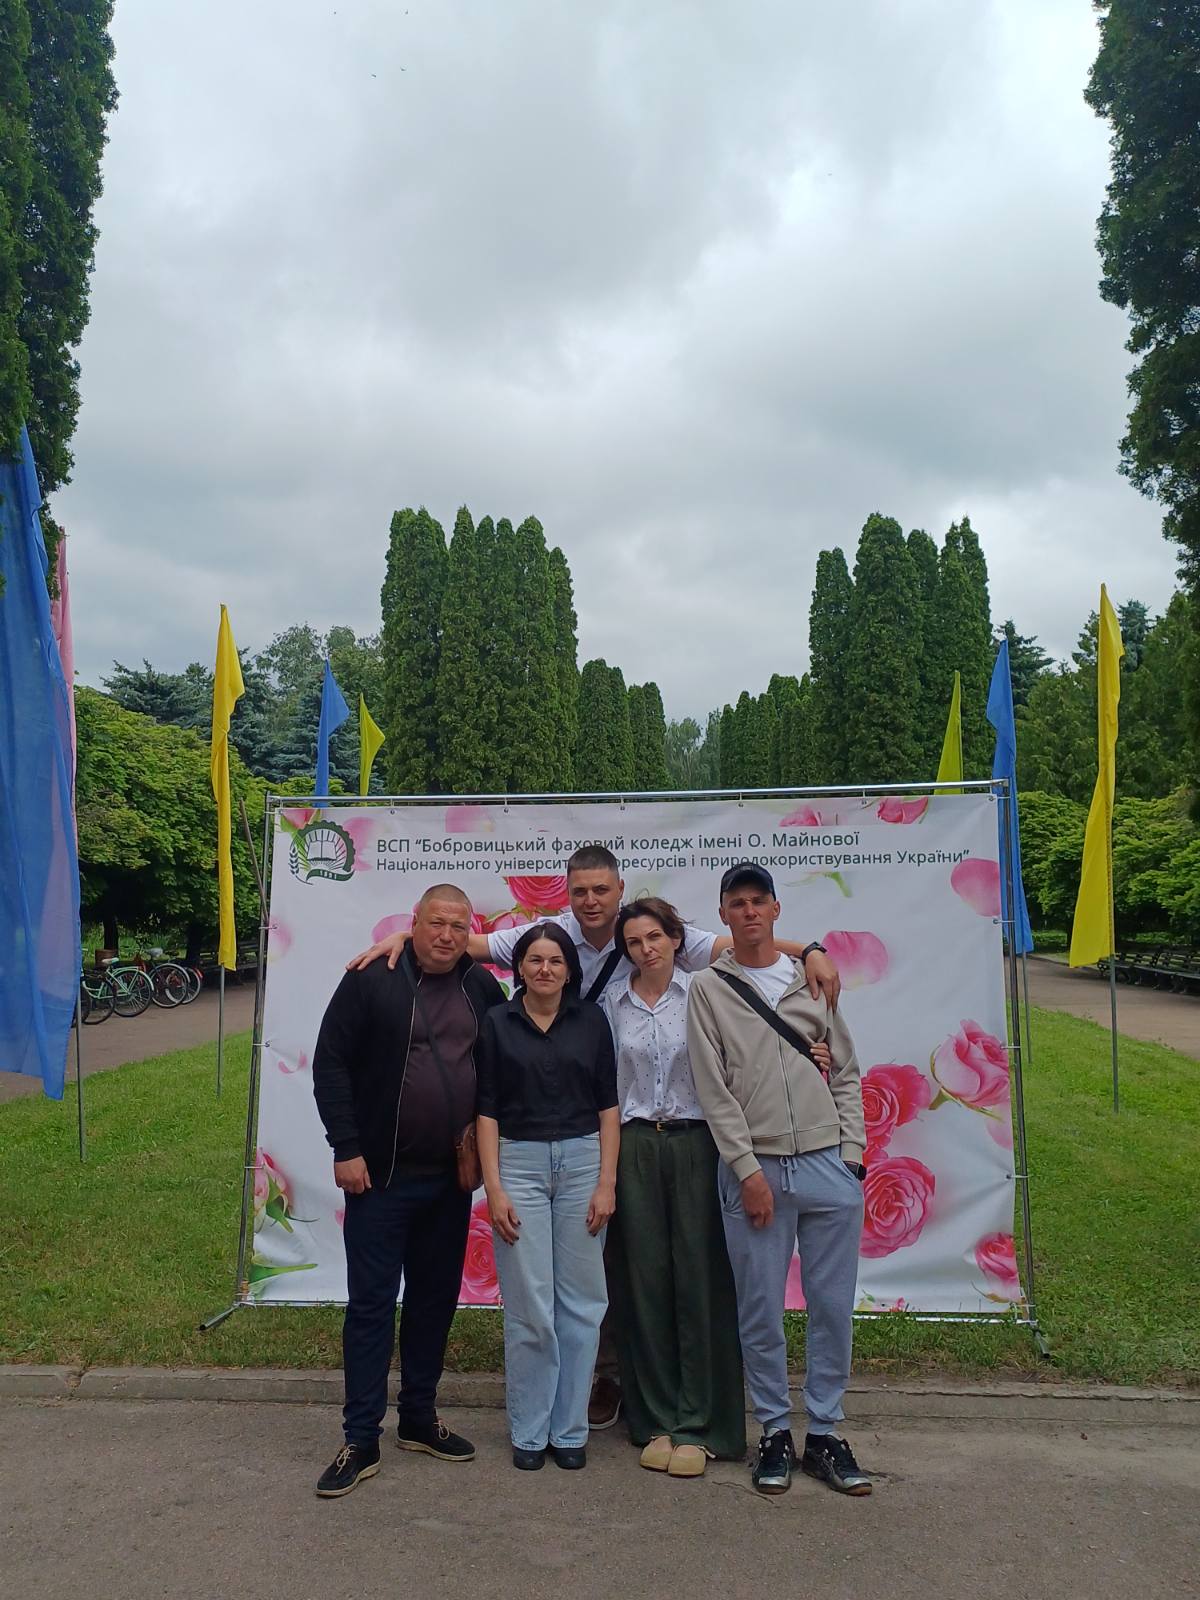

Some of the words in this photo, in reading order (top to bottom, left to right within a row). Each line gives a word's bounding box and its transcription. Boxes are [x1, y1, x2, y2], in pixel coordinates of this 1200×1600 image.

[377, 839, 410, 852] ВСП
[631, 837, 693, 852] коледж
[698, 834, 742, 848] імені
[748, 834, 766, 848] О.
[773, 831, 860, 847] Майнової
[377, 858, 490, 873] Національного
[495, 857, 569, 873] університ
[614, 854, 686, 871] оресурсів
[691, 855, 695, 867] і
